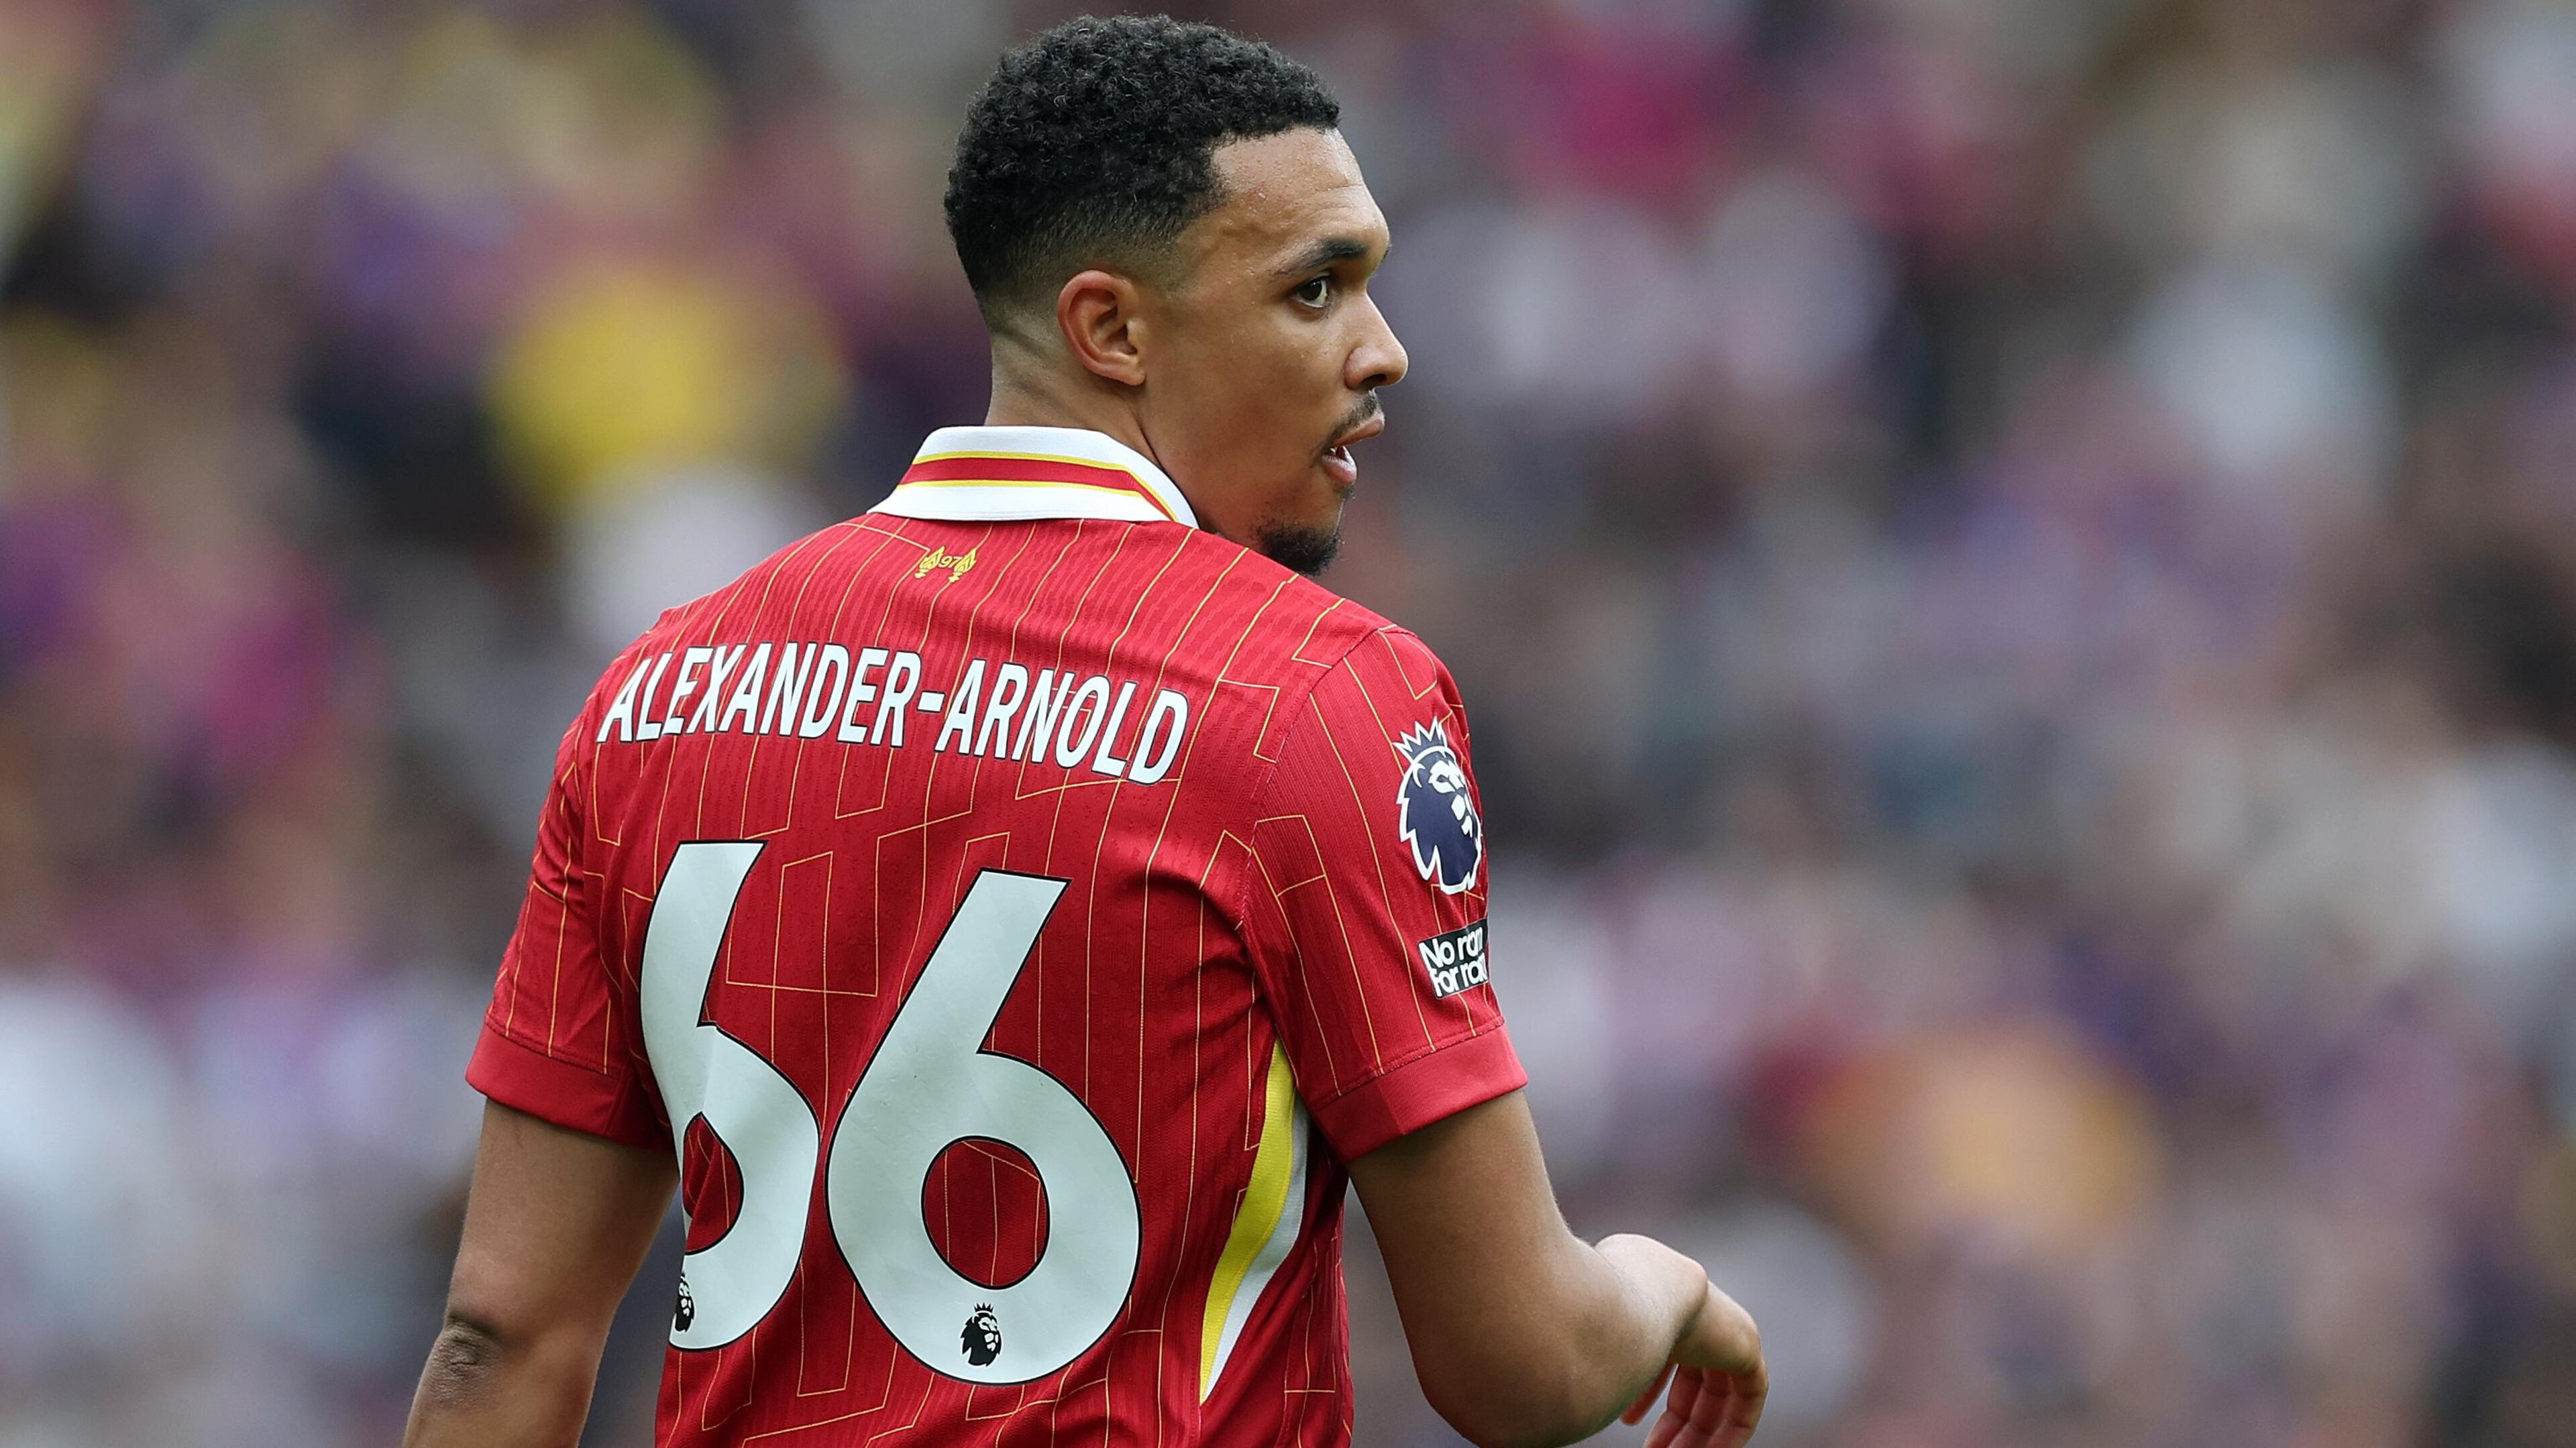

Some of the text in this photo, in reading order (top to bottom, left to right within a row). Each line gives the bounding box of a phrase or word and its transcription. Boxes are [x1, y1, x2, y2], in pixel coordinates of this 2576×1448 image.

[938, 555, 962, 568] 97
[596, 641, 1189, 785] ALEXANDER-ARNOLD
[1419, 938, 1454, 968] No
[1429, 966, 1459, 997] for
[639, 839, 1143, 1386] 66
